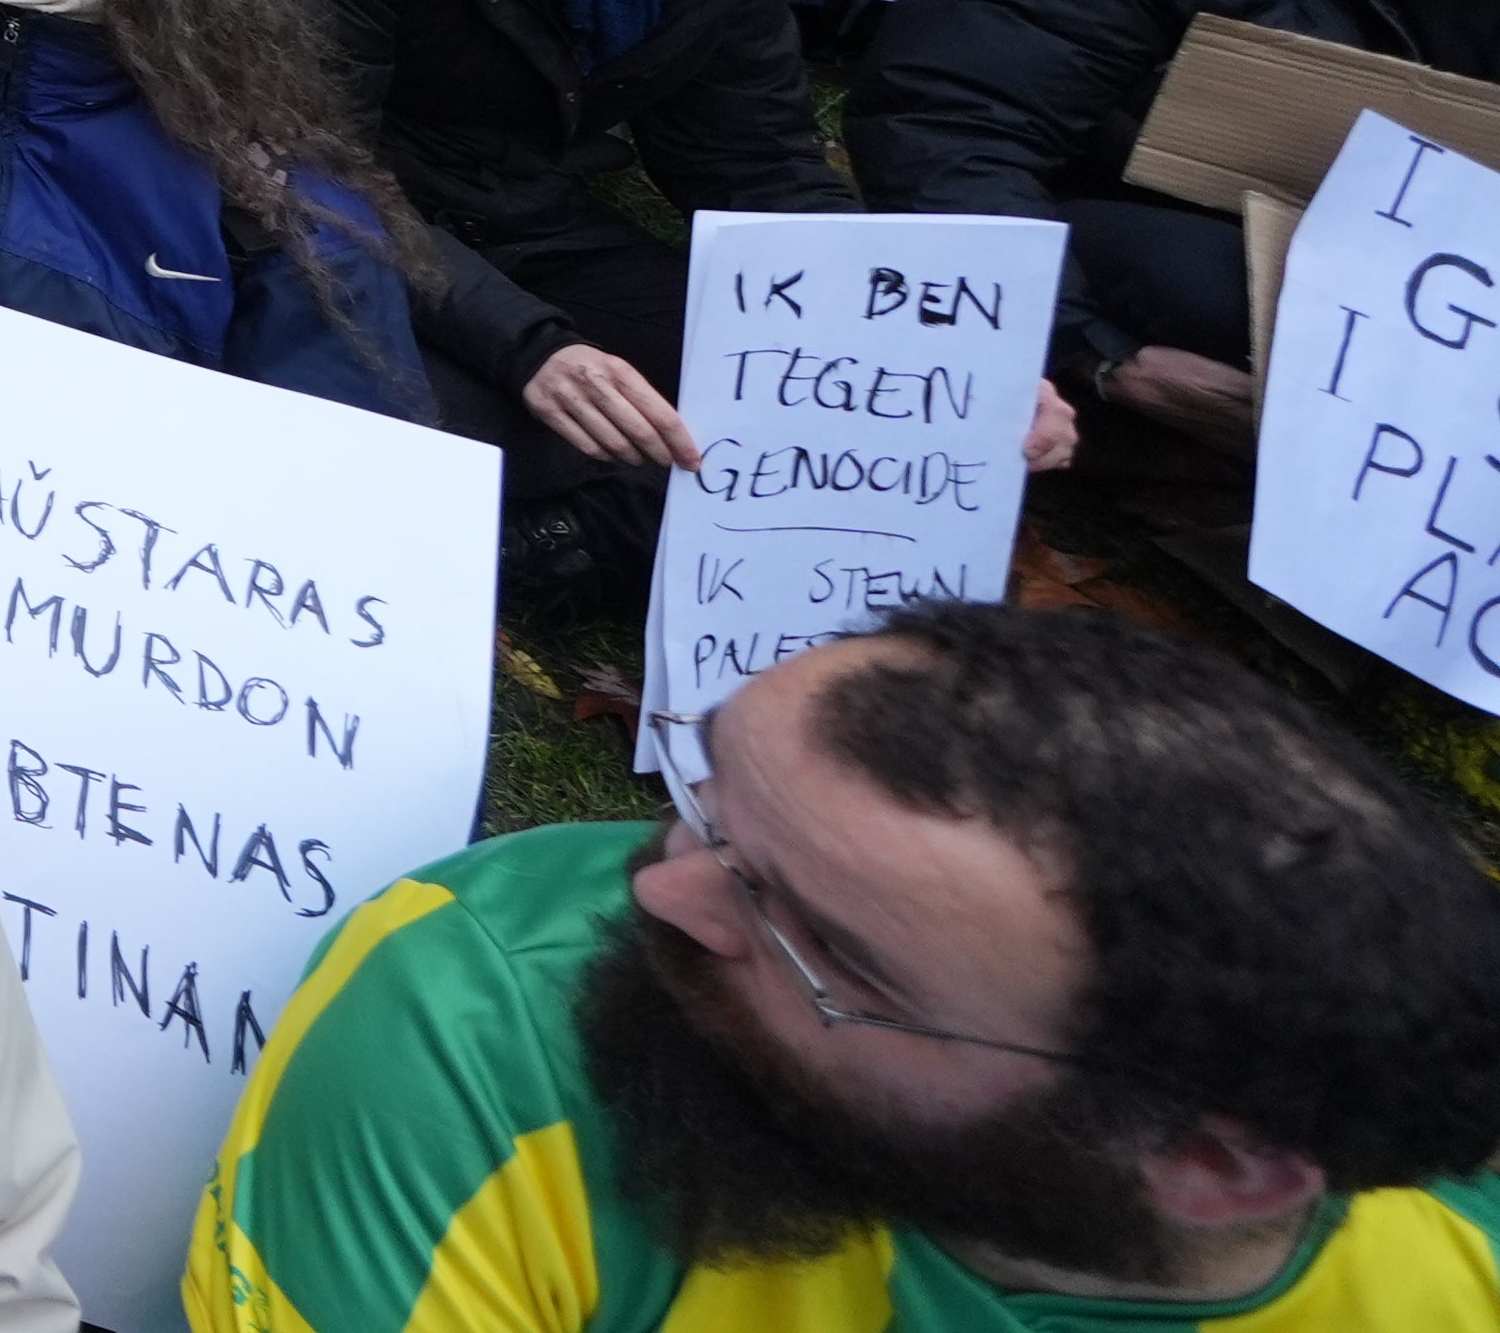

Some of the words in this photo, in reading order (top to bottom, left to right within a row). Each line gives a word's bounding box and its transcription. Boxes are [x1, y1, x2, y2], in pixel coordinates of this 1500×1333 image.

[1375, 135, 1445, 229] I
[733, 268, 807, 320] IK
[864, 266, 1003, 332] BEN
[723, 347, 977, 426] TEGEN
[1318, 304, 1371, 403] I
[694, 436, 987, 514] GENOCIDE
[697, 552, 746, 605] IK
